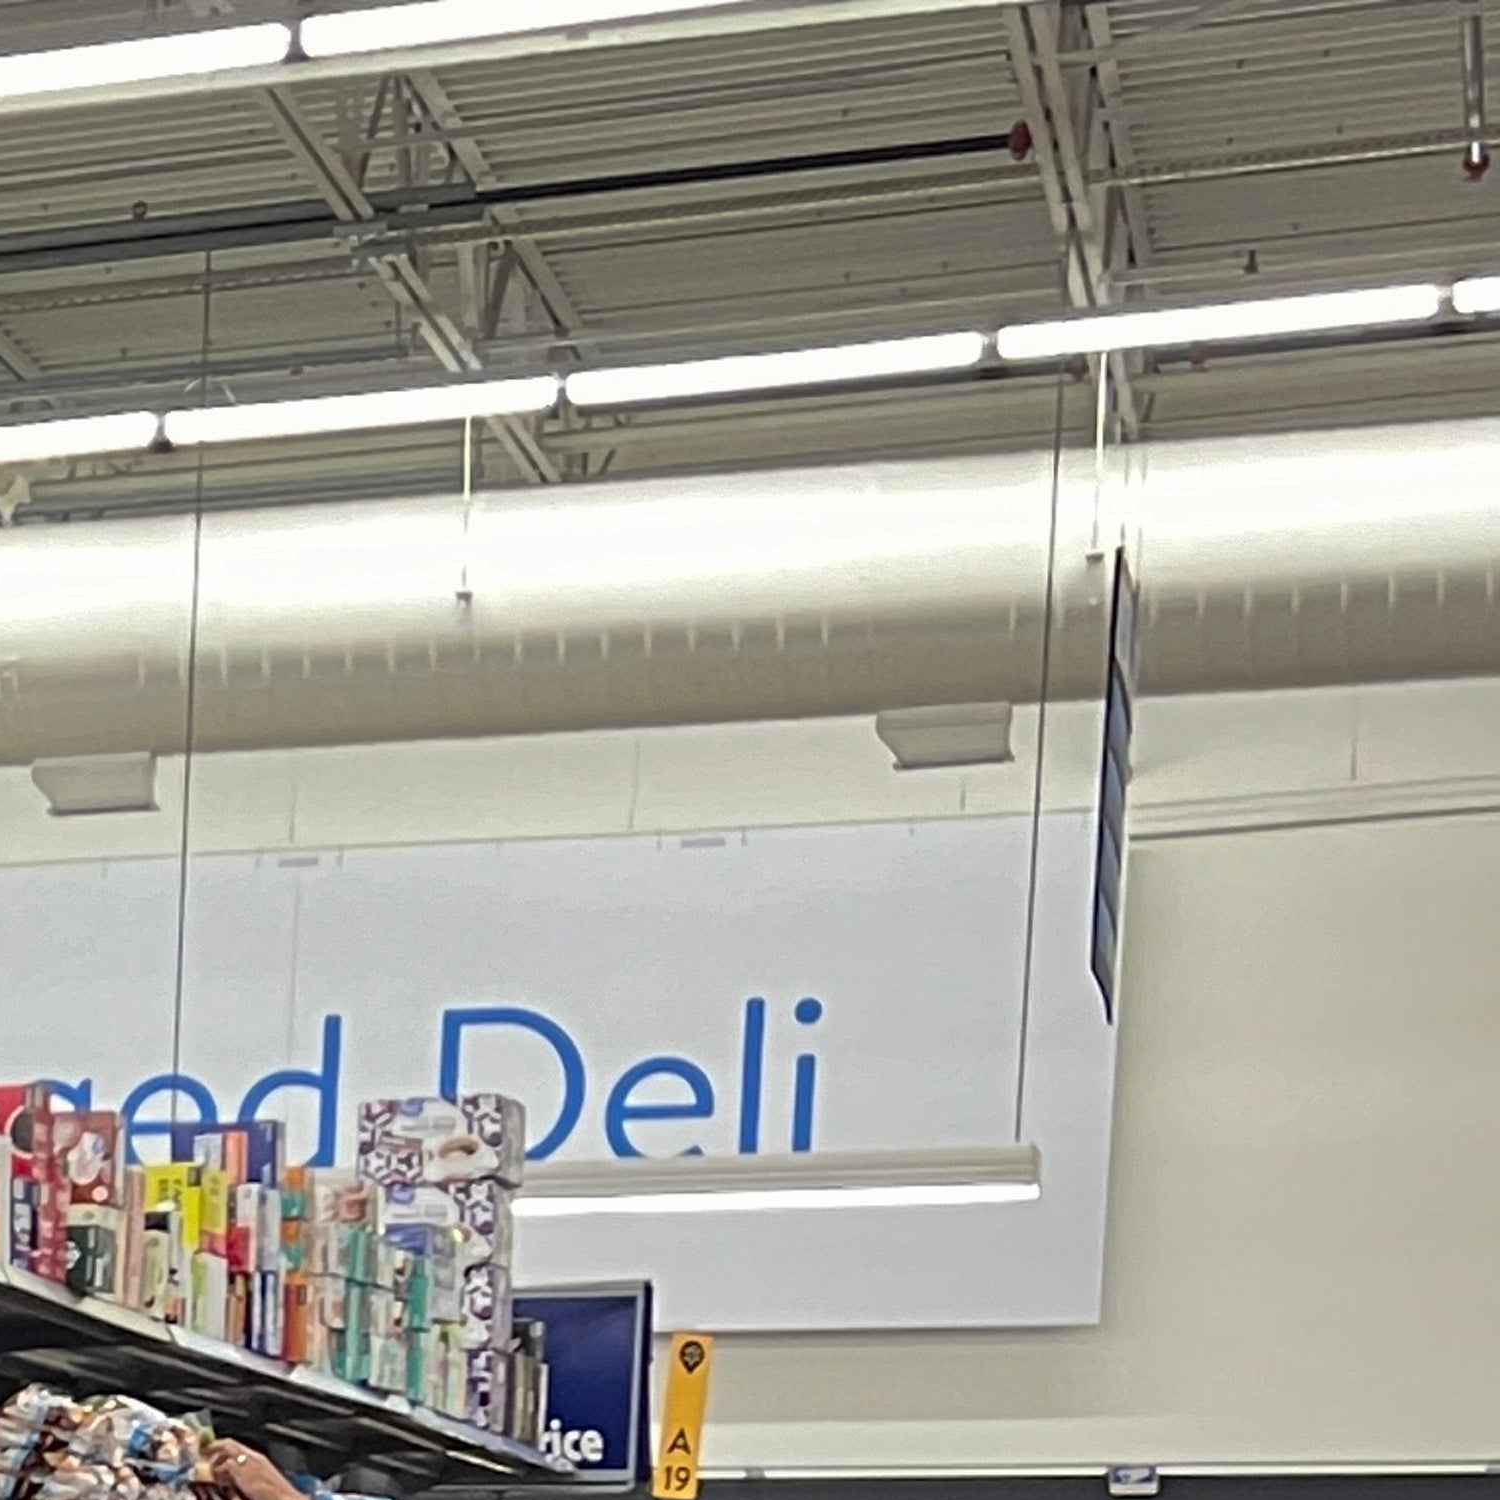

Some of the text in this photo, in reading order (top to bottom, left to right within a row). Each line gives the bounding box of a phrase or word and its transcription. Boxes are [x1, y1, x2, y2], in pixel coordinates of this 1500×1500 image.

[439, 996, 823, 1162] Deli
[538, 1418, 604, 1462] rice
[667, 1427, 691, 1454] A
[664, 1466, 691, 1491] 19
